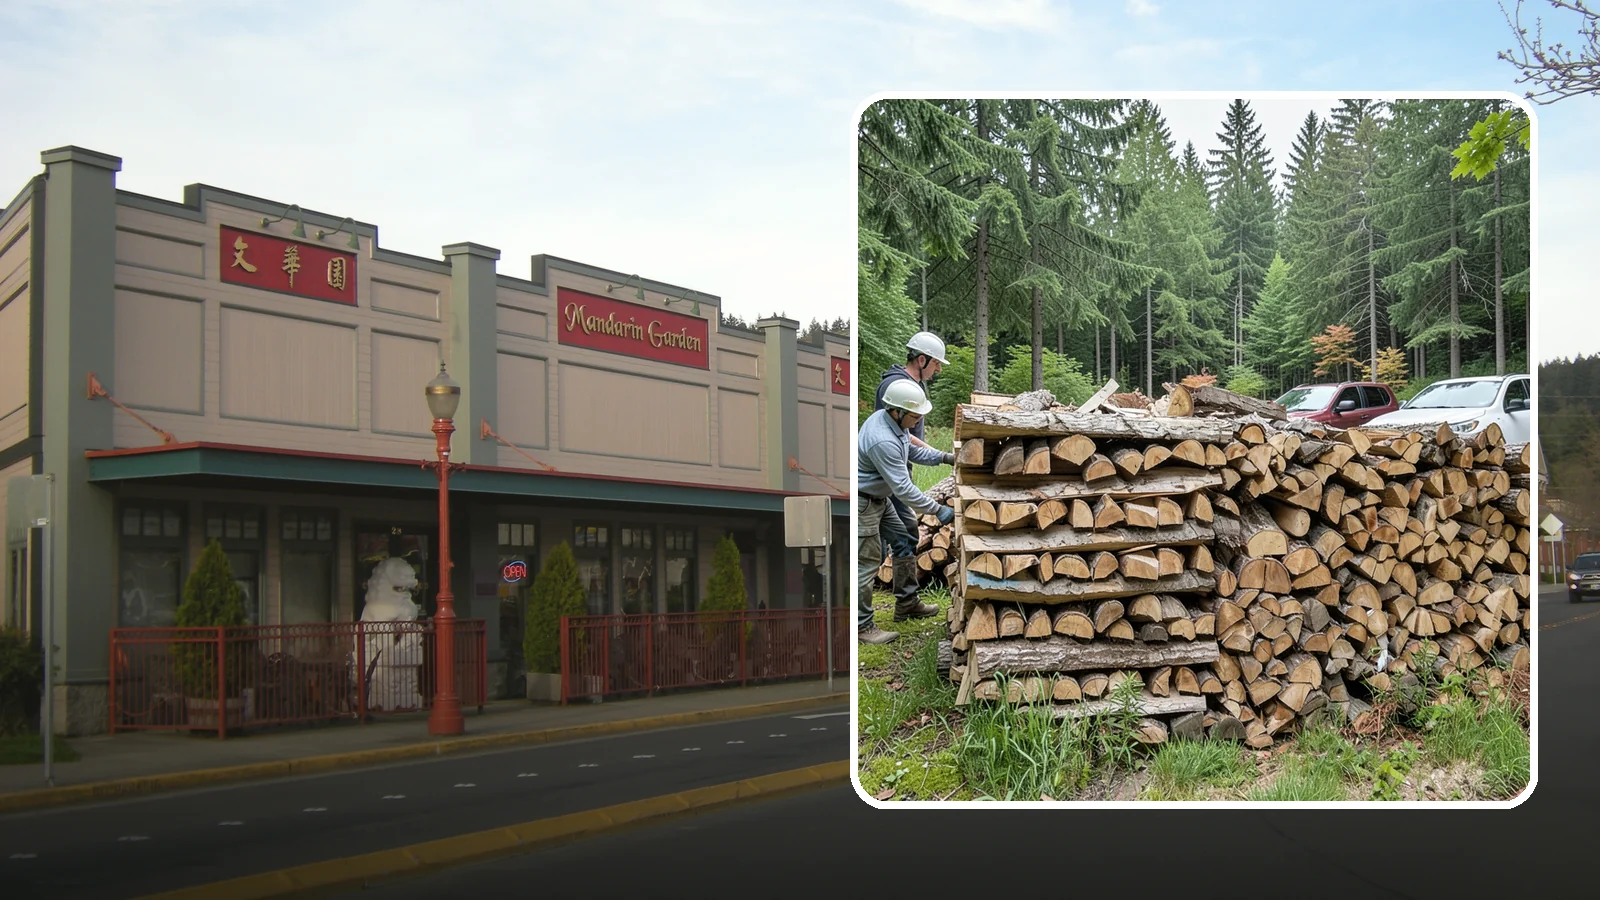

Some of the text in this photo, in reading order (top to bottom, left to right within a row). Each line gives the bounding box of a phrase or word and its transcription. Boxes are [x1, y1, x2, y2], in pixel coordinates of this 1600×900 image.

[230, 235, 346, 291] 文華園
[564, 302, 701, 352] Mandarin Garden
[503, 565, 527, 578] OPEN
